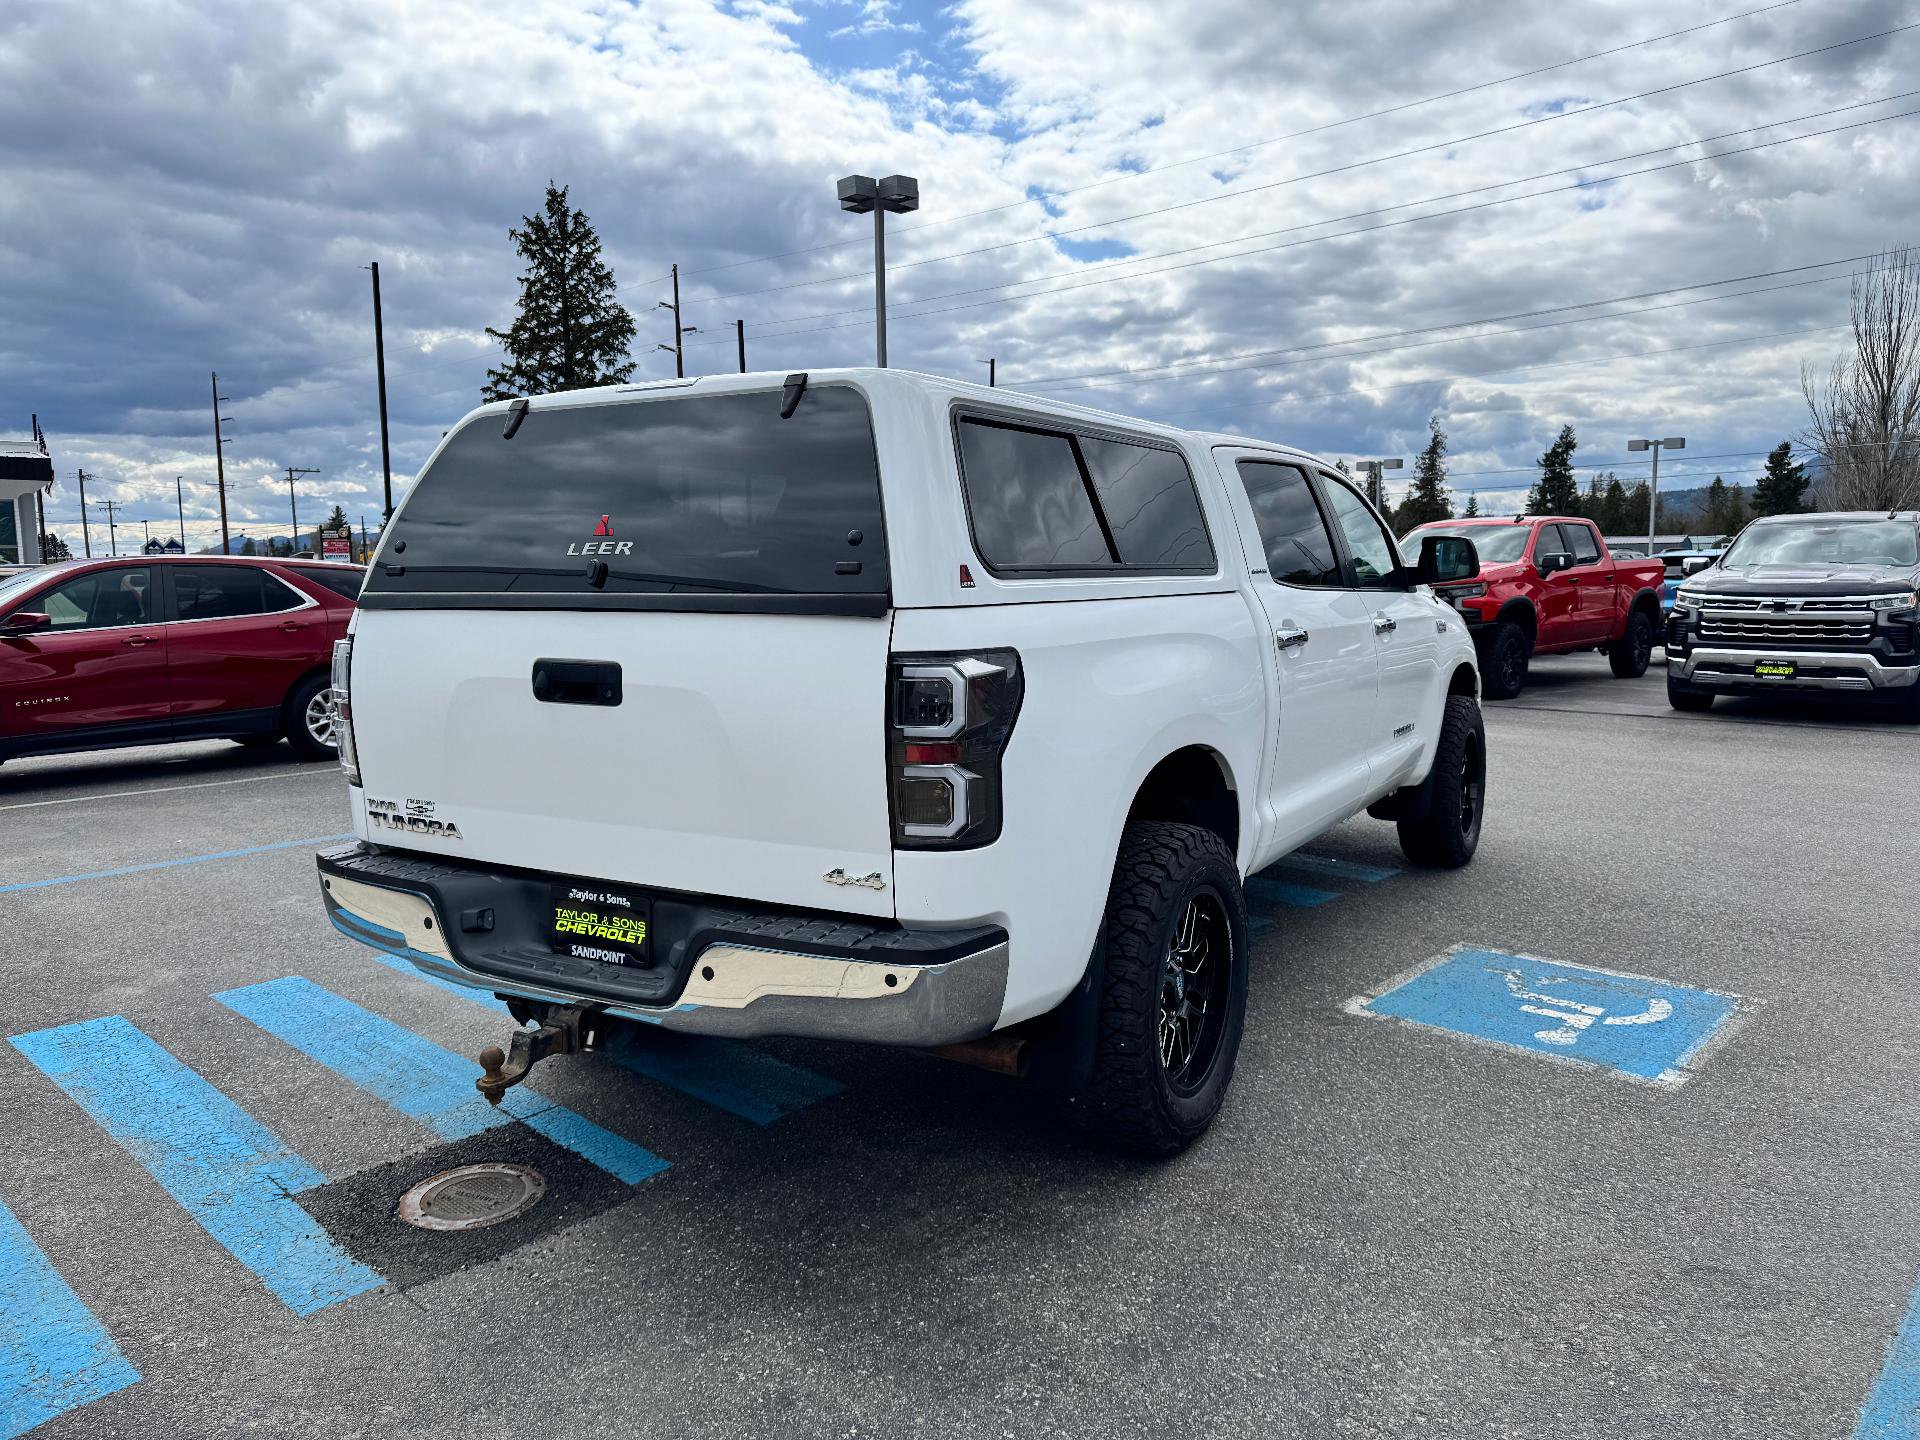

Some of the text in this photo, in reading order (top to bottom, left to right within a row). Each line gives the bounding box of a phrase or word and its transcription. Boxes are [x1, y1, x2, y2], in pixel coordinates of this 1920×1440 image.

[566, 541, 634, 556] LEER
[15, 696, 69, 707] EQUINOX
[368, 811, 463, 840] TUNDRA
[571, 888, 627, 906] Taylor & Sons
[555, 908, 646, 932] TAYLOR & SONS
[555, 920, 646, 945] CHEVROLET
[571, 944, 626, 964] SANDPOINT
